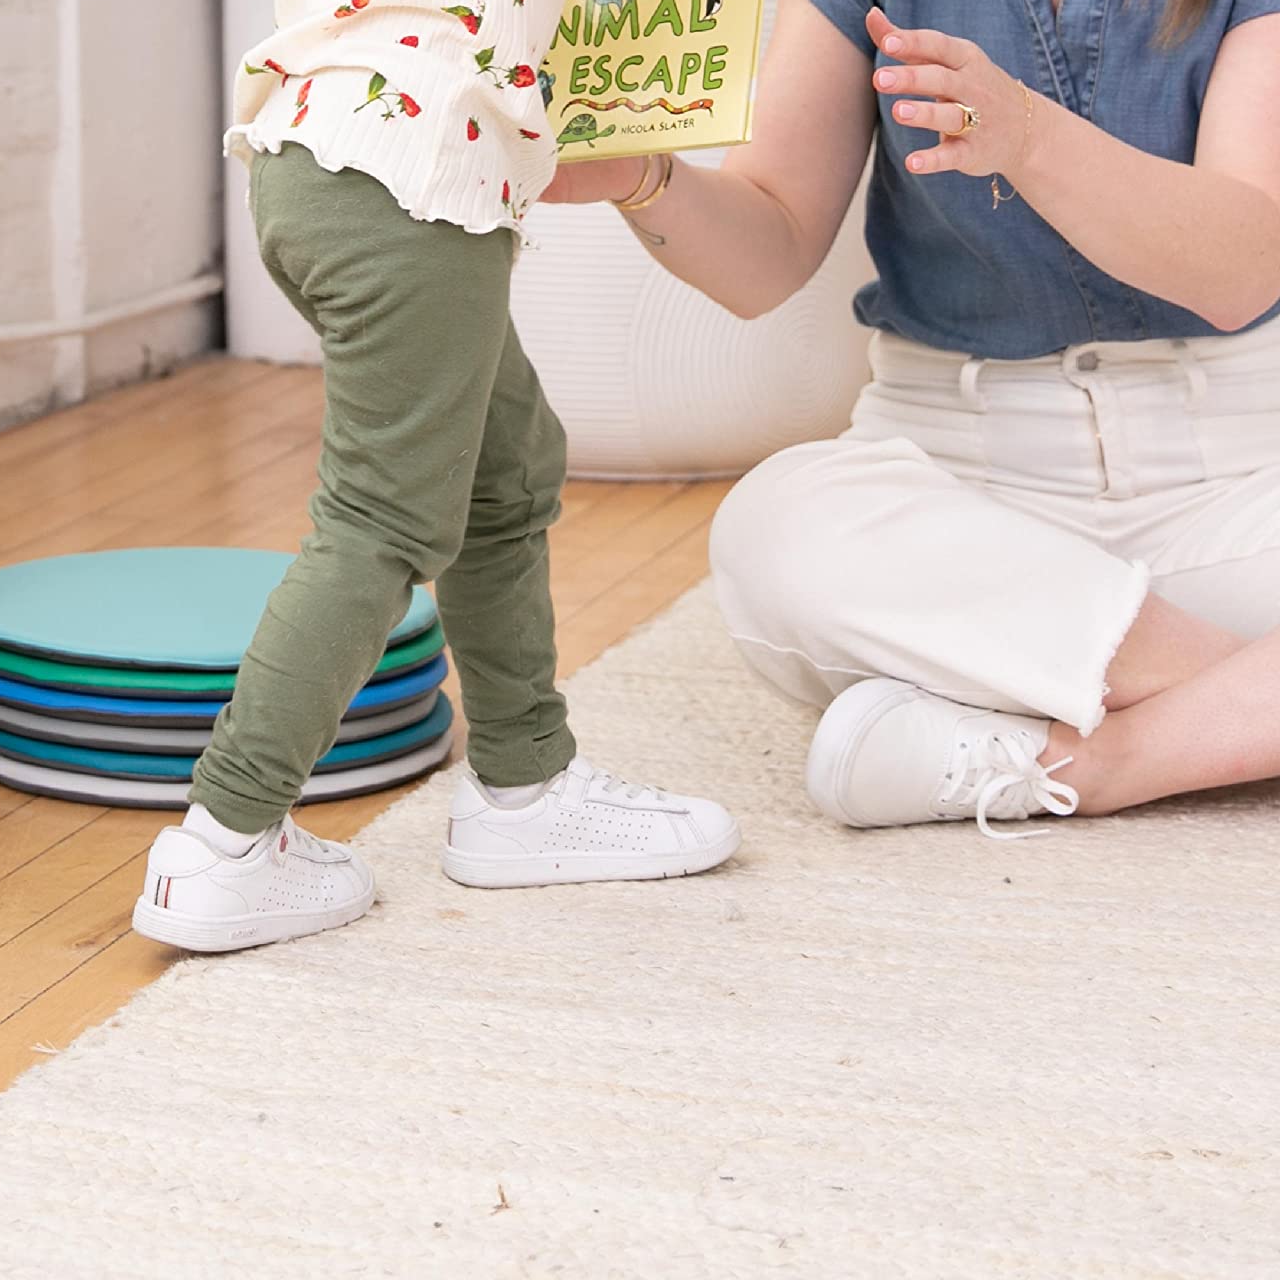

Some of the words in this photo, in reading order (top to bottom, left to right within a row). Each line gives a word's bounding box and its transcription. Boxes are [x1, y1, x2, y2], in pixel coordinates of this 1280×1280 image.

[570, 45, 728, 96] ESCAPE
[621, 123, 655, 134] NICOLA
[658, 118, 695, 132] SLATER
